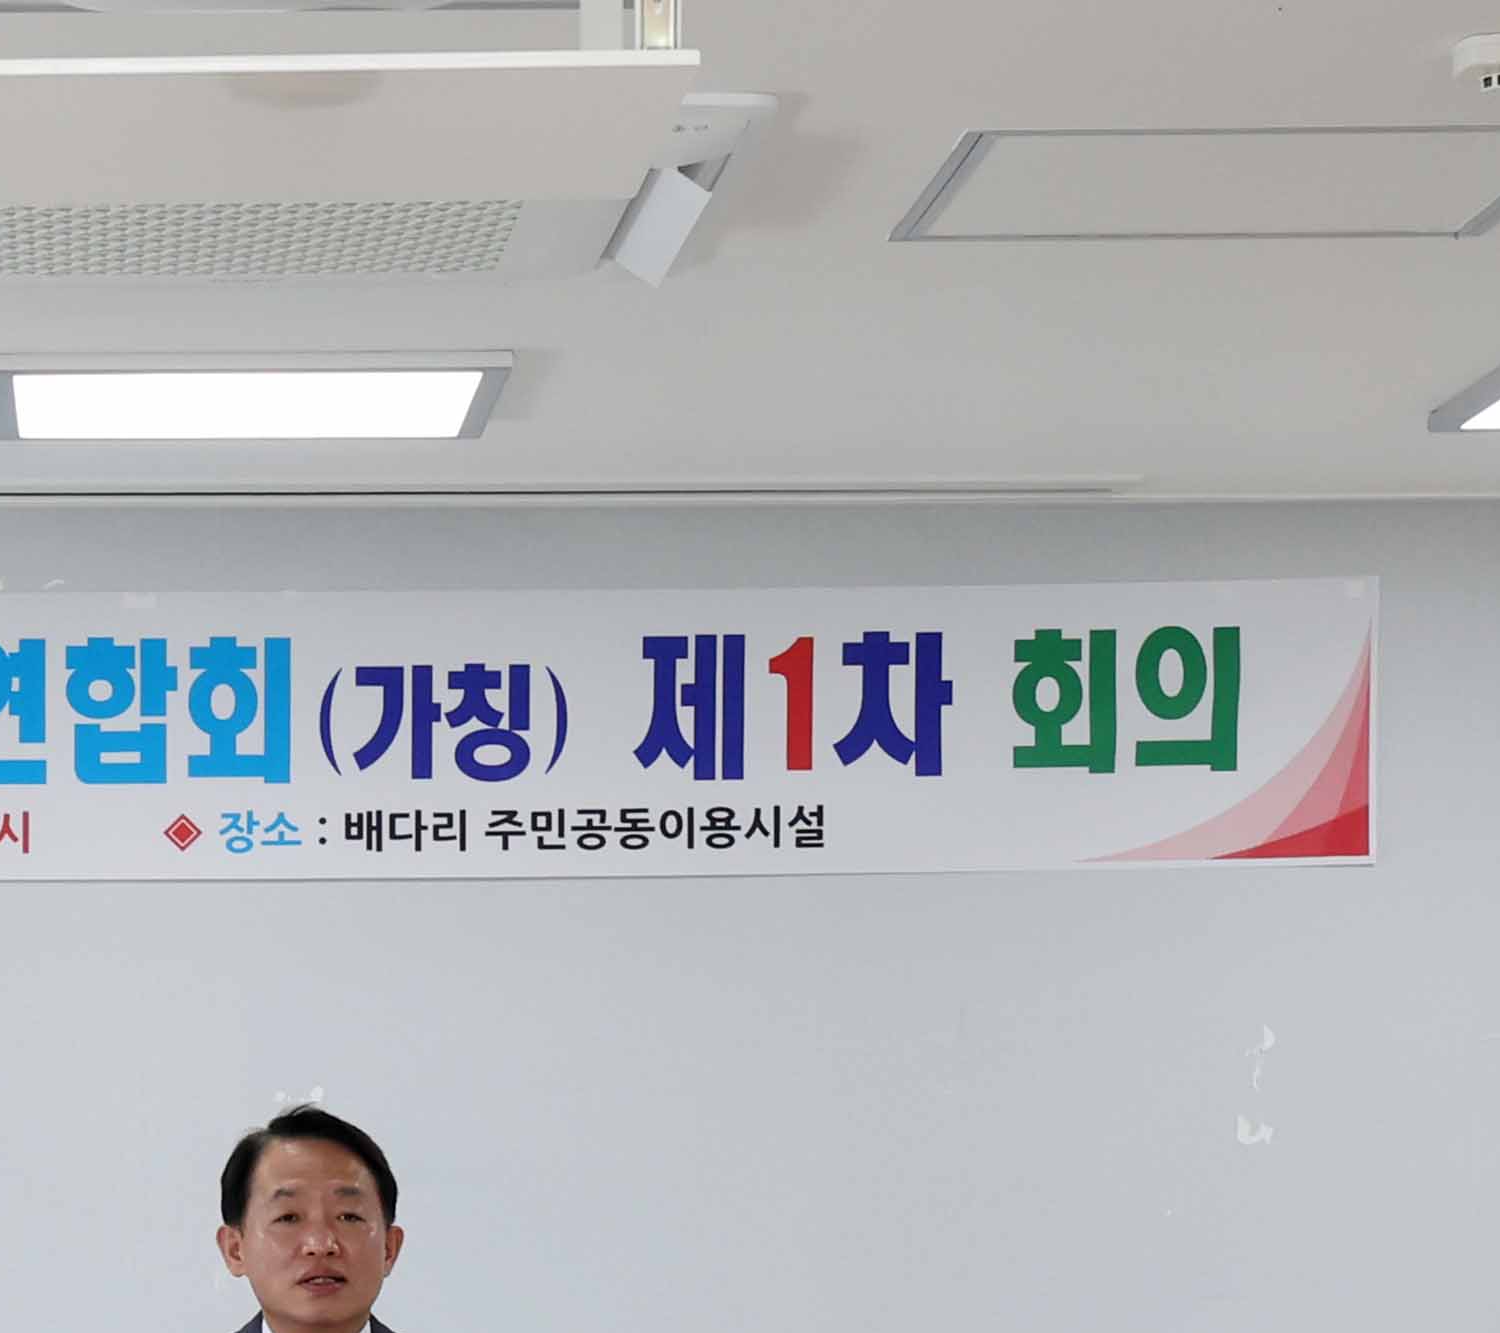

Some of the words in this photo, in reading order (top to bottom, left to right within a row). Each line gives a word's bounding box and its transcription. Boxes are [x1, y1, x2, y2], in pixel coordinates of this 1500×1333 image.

[633, 631, 953, 781] 제1차
[1012, 626, 1241, 775] 회의
[218, 809, 303, 855] 장소
[344, 808, 467, 853] 배다리
[484, 803, 825, 852] 주민공동이용시설
